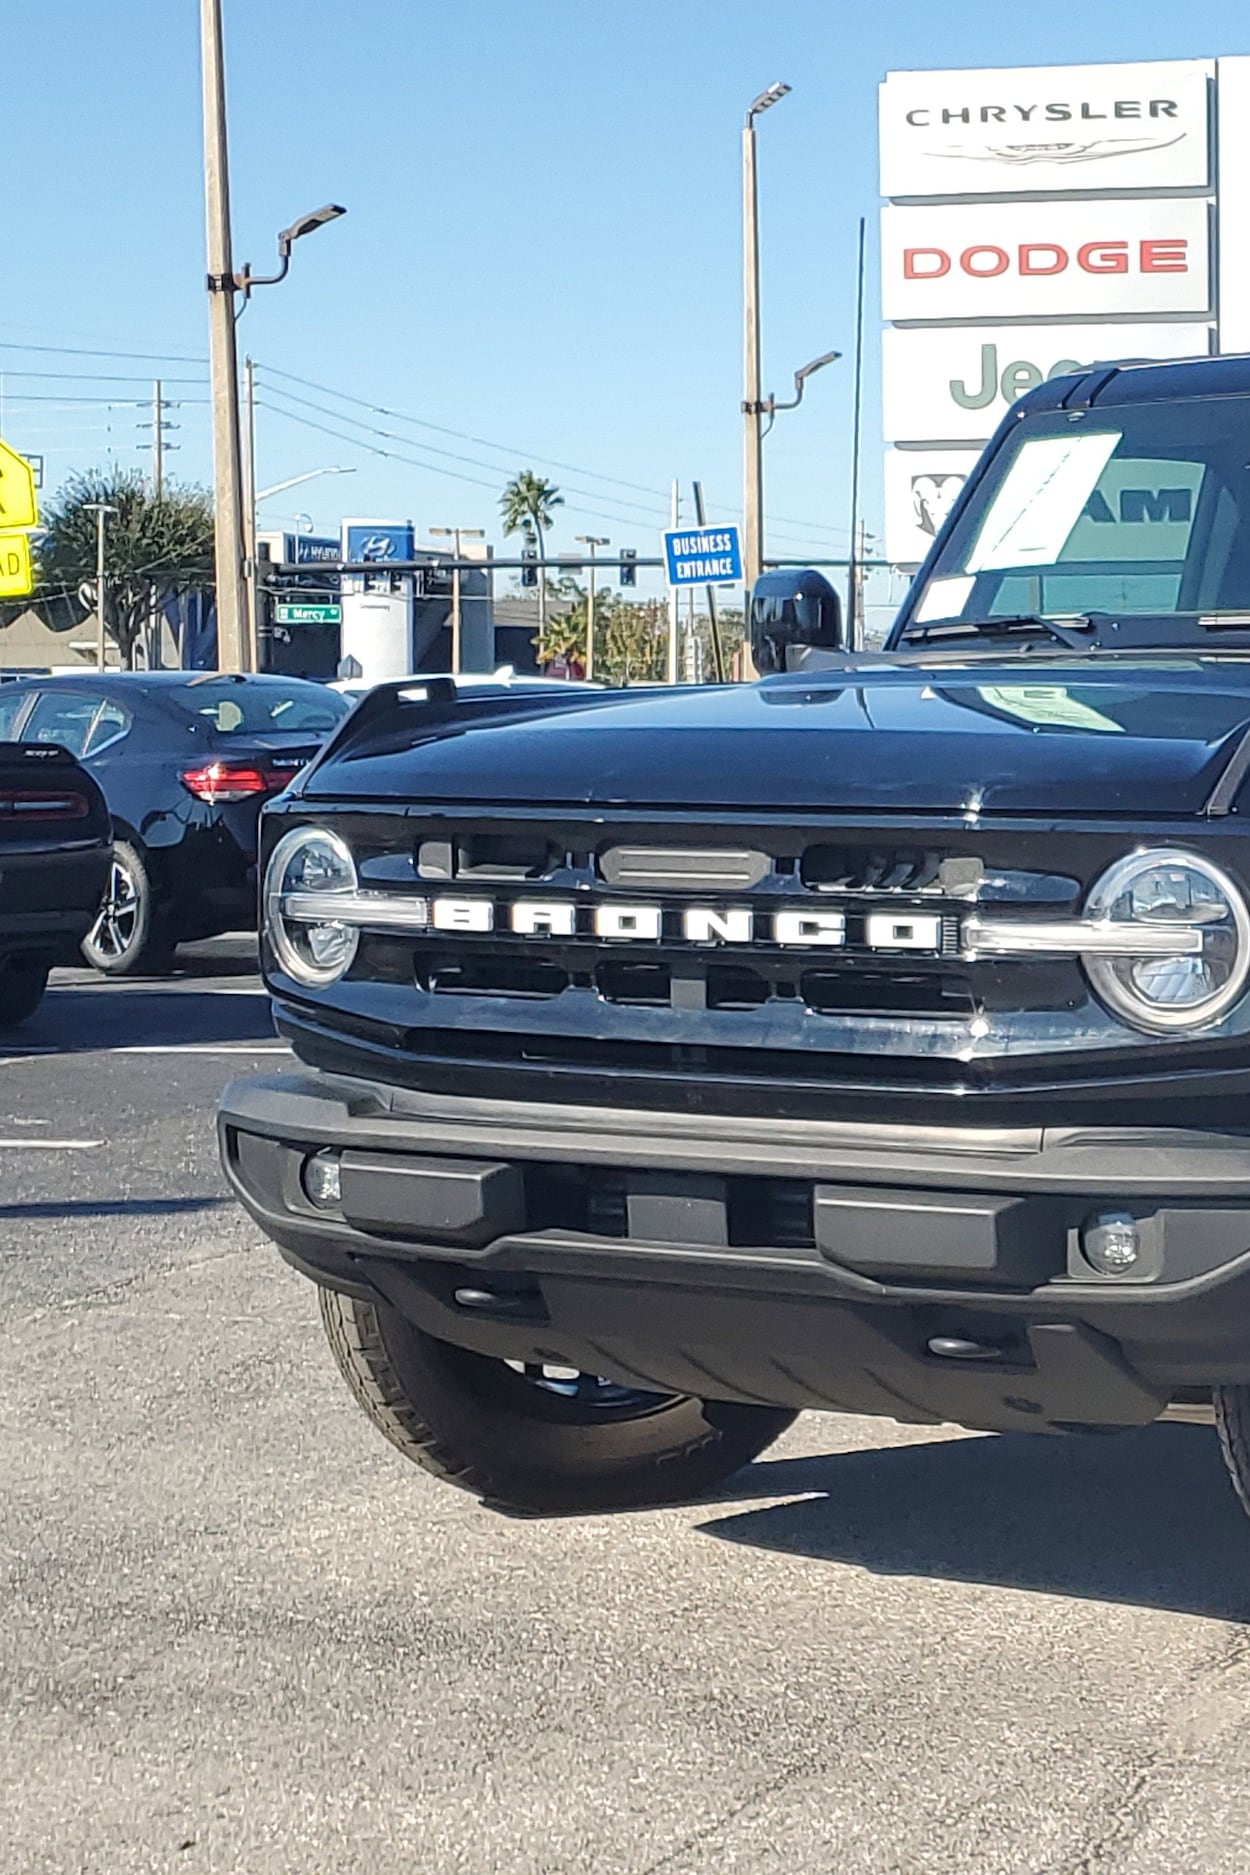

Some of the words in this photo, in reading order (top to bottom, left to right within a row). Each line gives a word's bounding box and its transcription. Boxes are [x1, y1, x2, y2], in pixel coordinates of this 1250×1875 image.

[906, 100, 1179, 126] CHRYSLER
[903, 239, 1188, 279] DODGE
[949, 343, 1084, 410] Je
[1080, 488, 1192, 523] AM
[672, 533, 732, 557] BUSINESS
[676, 557, 734, 579] ENTRANCE
[293, 608, 326, 620] Mercy
[432, 899, 942, 950] BRONCO
